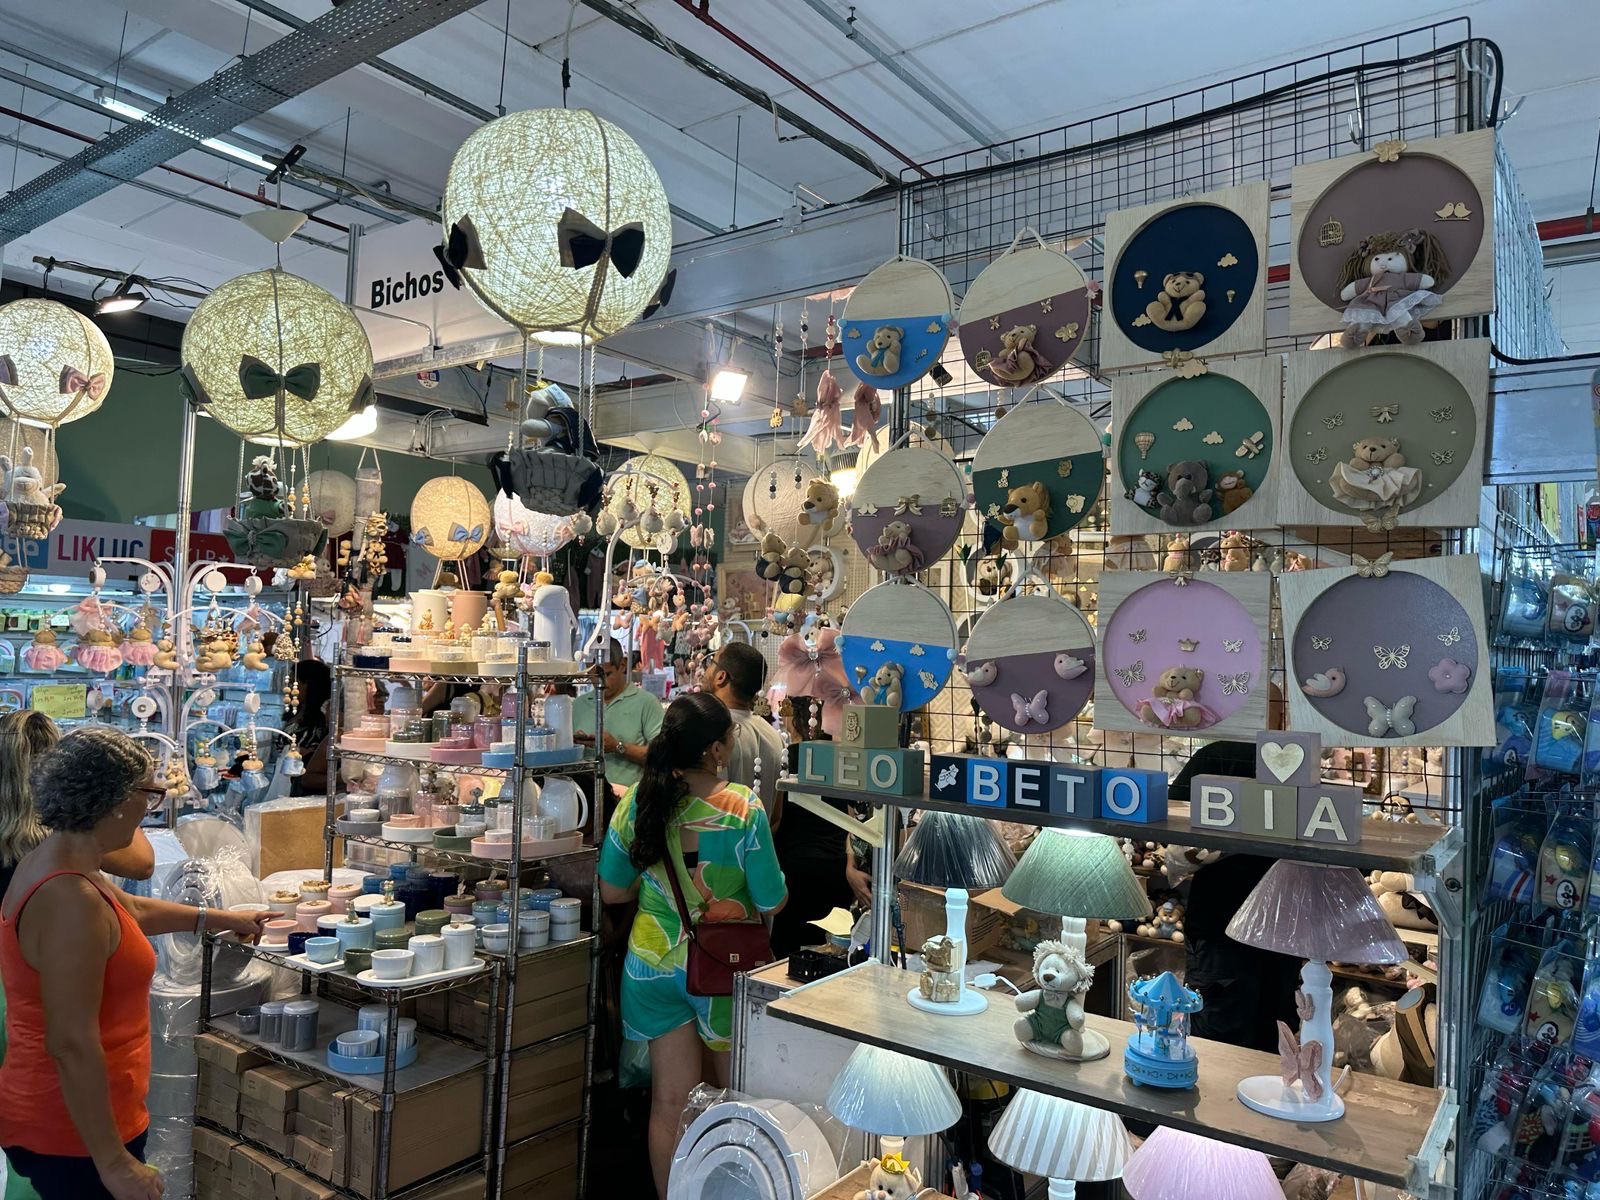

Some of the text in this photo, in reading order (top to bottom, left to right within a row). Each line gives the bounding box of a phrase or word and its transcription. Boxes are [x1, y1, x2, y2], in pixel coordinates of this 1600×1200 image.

[371, 271, 444, 309] Bichos
[58, 534, 144, 564] LIKLUC
[164, 546, 216, 564] SIP
[804, 747, 898, 788] LEO
[973, 765, 1142, 815] BETO
[1200, 786, 1348, 841] BIA
